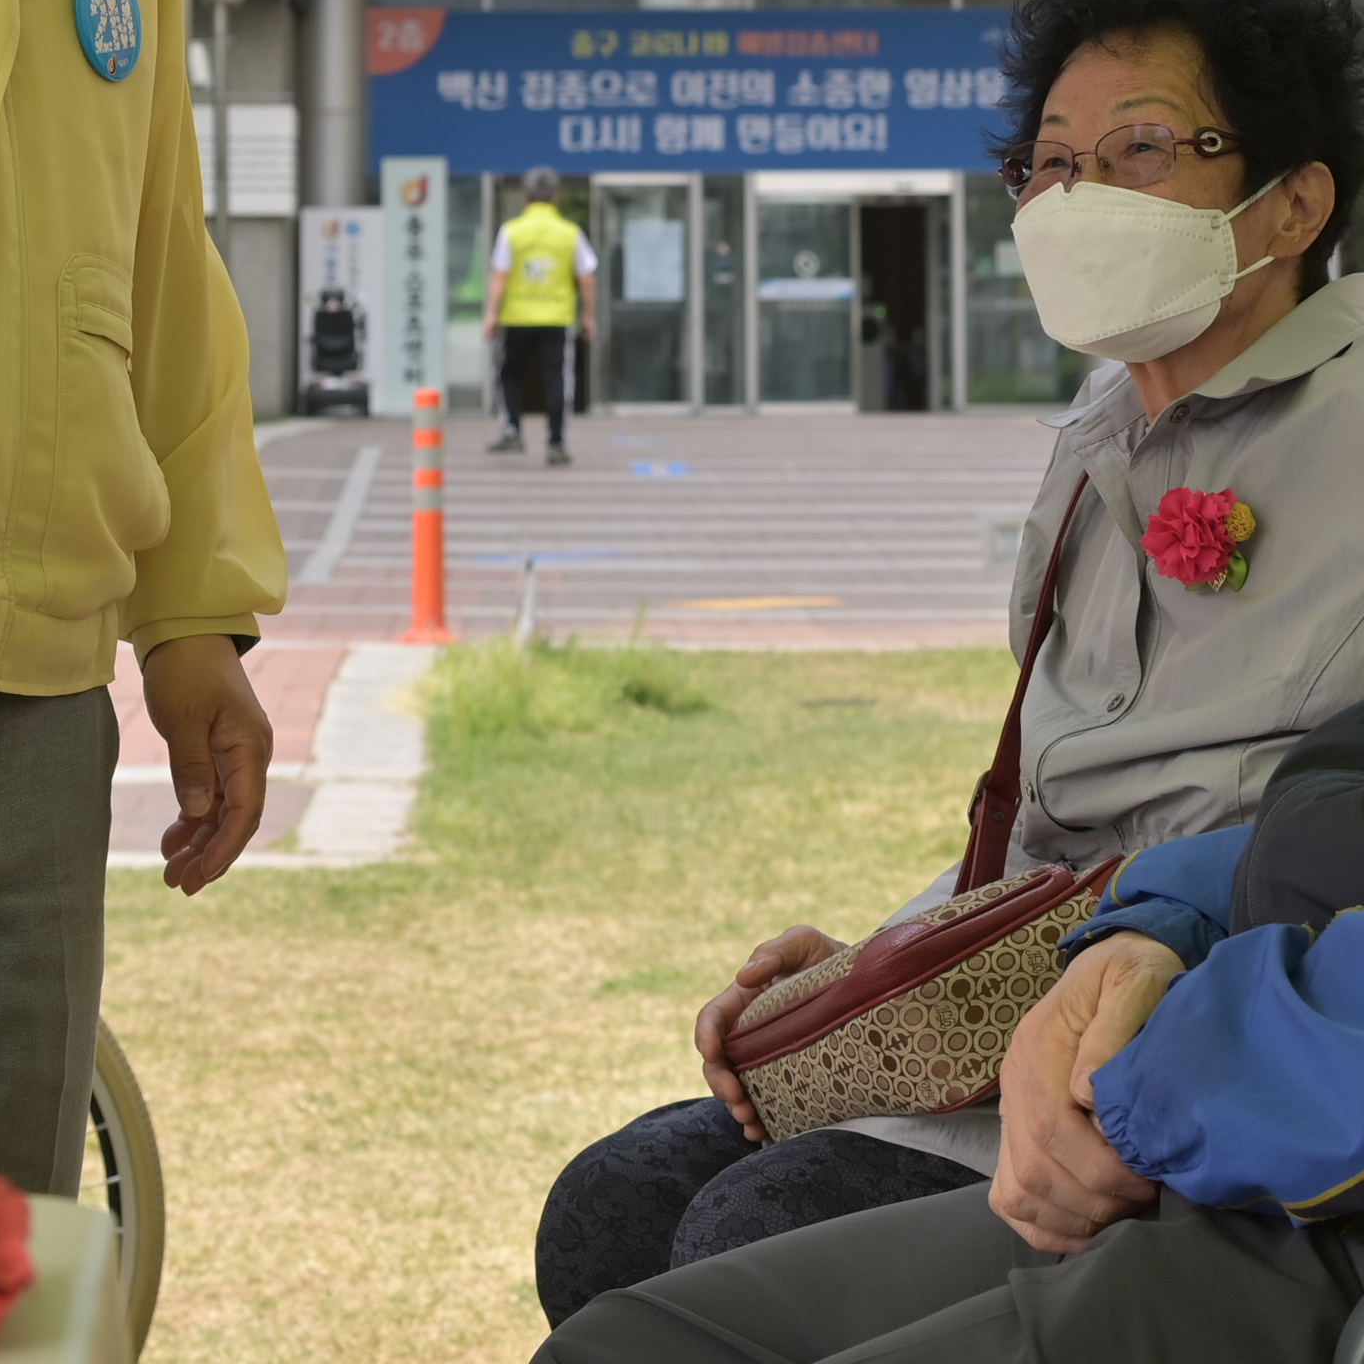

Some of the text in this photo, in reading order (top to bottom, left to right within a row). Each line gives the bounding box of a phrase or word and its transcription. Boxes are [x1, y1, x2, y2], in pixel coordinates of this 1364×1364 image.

[437, 69, 509, 111] 백신
[520, 69, 659, 111] 접종으로
[788, 68, 893, 110] 소중한
[653, 113, 727, 155] 함께
[737, 112, 888, 155] 만들어요!
